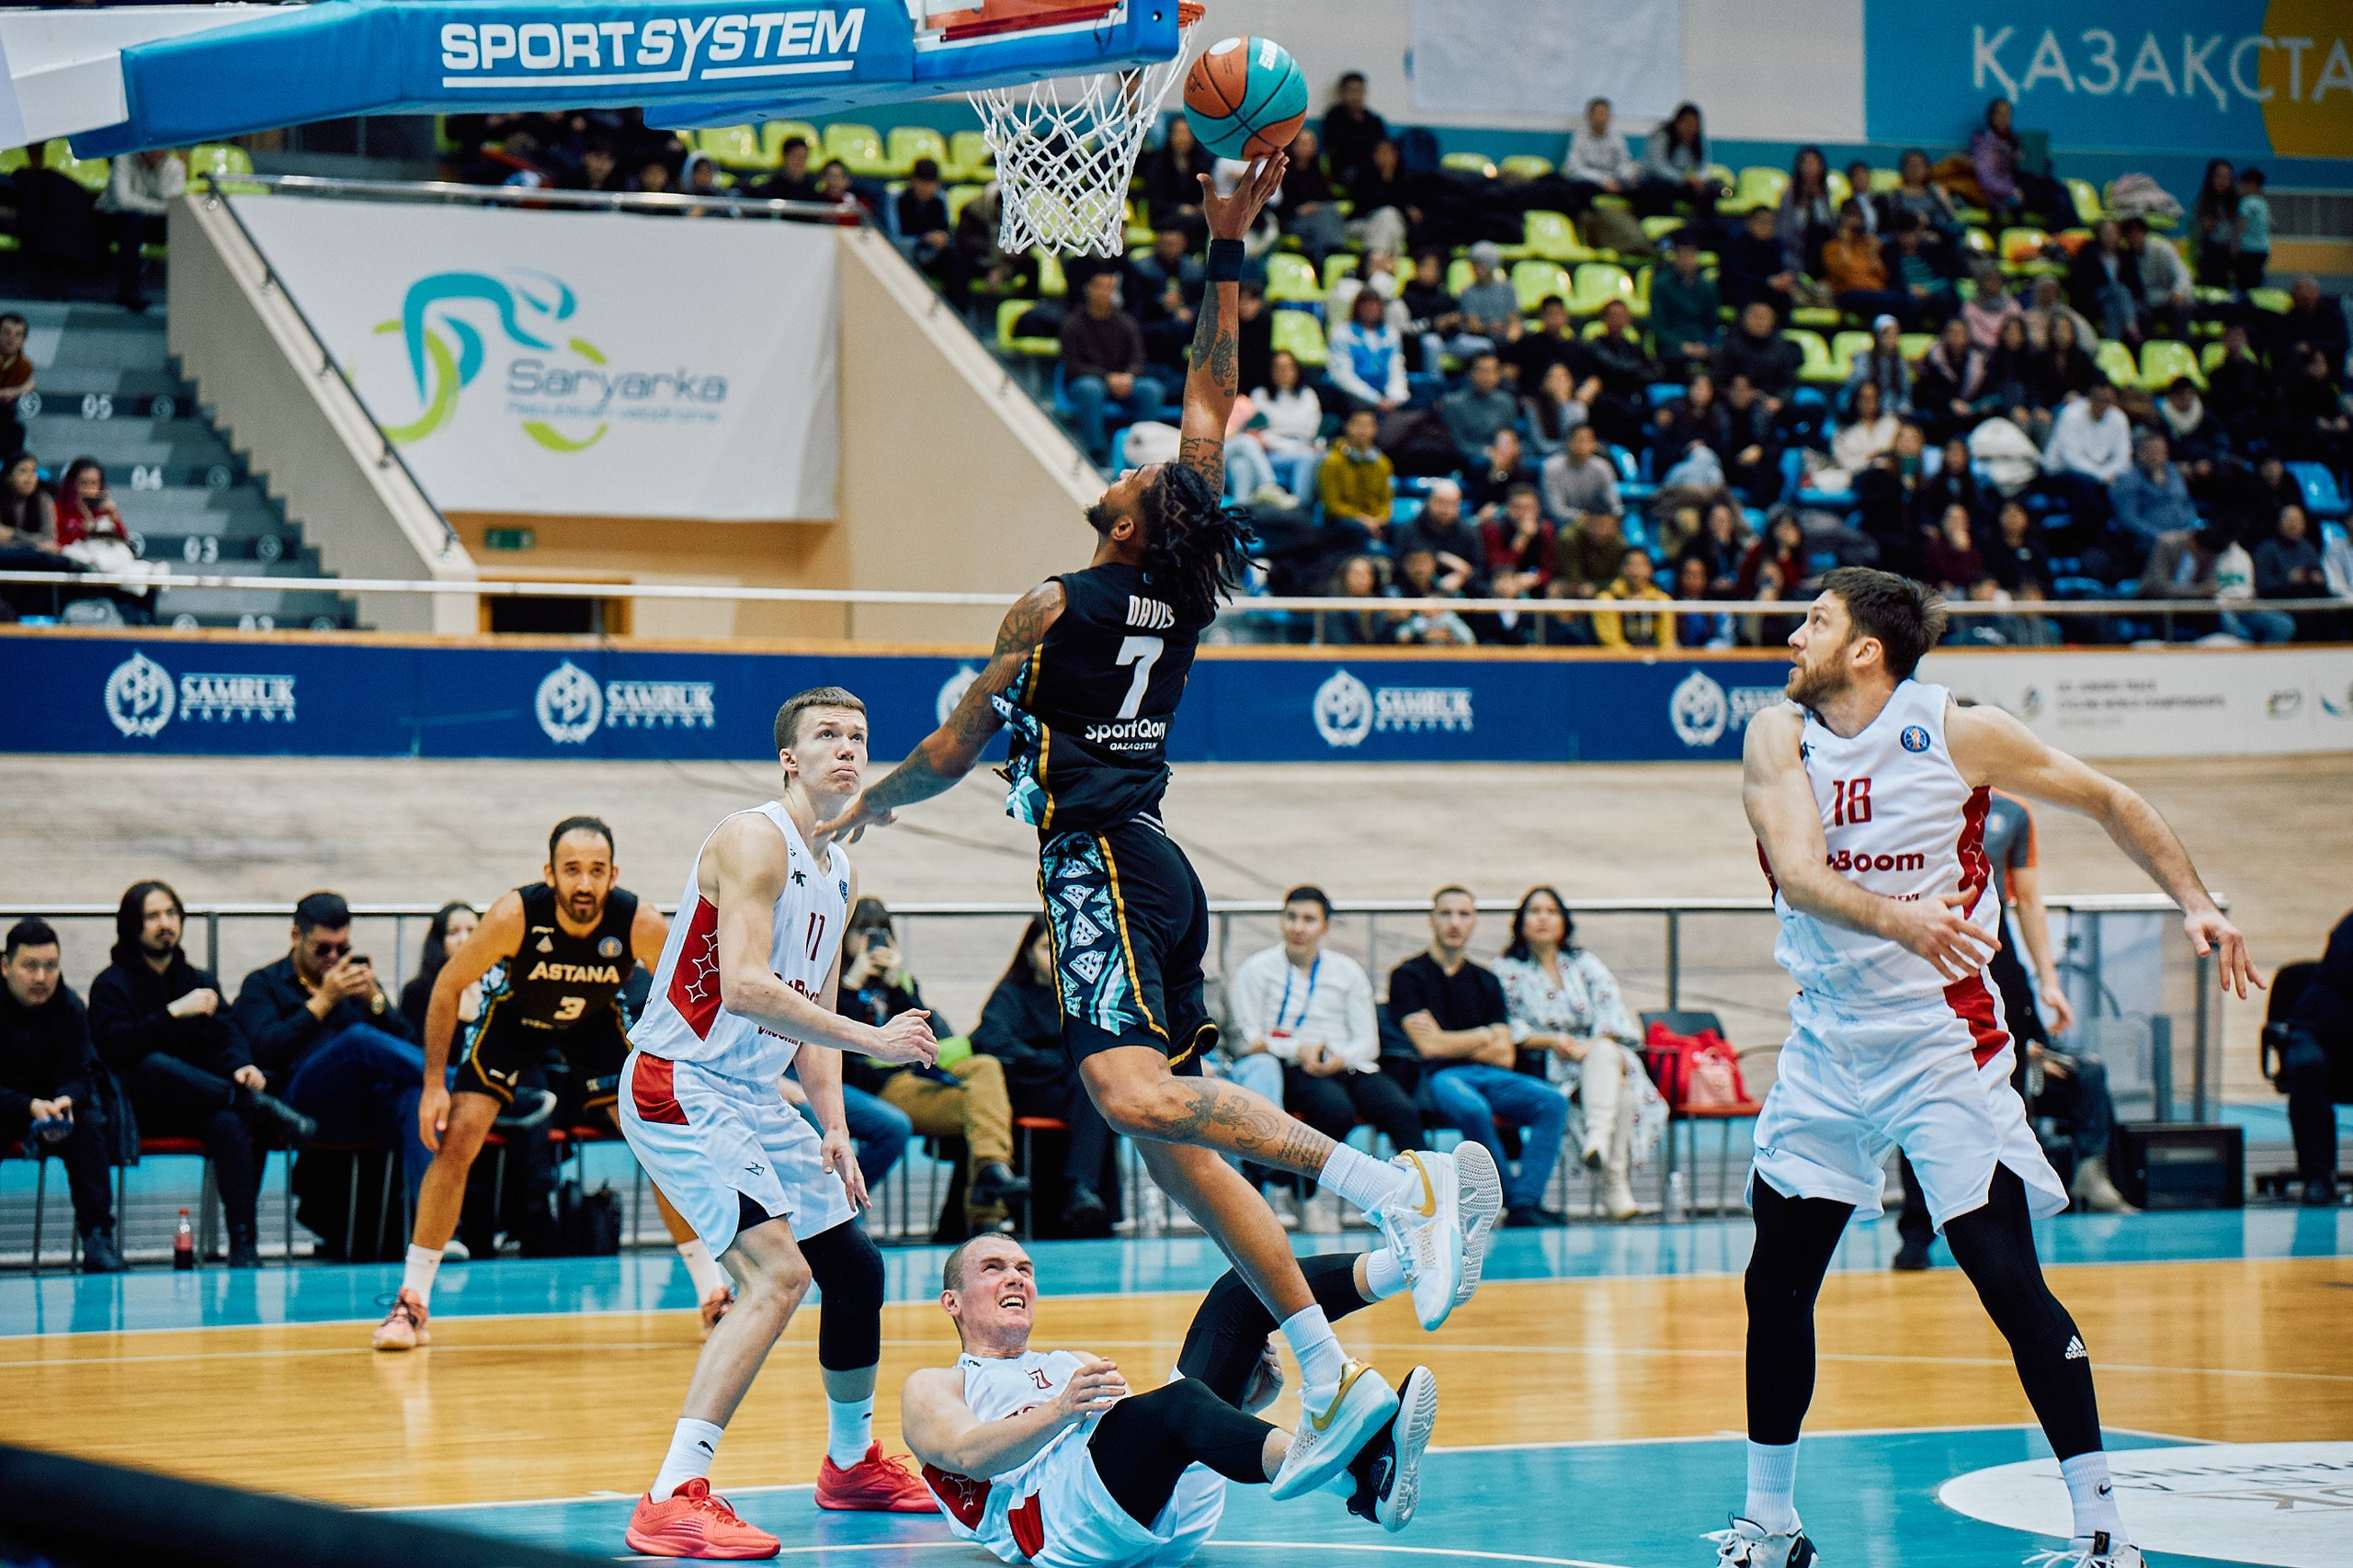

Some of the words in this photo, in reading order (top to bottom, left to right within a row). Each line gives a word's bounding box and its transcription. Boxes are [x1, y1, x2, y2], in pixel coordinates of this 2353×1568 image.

[506, 358, 728, 415] Saryarka
[81, 392, 113, 421] 05
[131, 464, 163, 492] 04
[184, 534, 219, 564] 03
[1126, 595, 1176, 630] DAVIS
[1115, 635, 1165, 720] 7
[1109, 742, 1158, 751] QAZAQSTAN
[1833, 778, 1872, 827] 18
[805, 912, 825, 961] 11
[527, 960, 621, 984] ASTANA
[552, 995, 586, 1020] 3
[1024, 1367, 1053, 1390] 7
